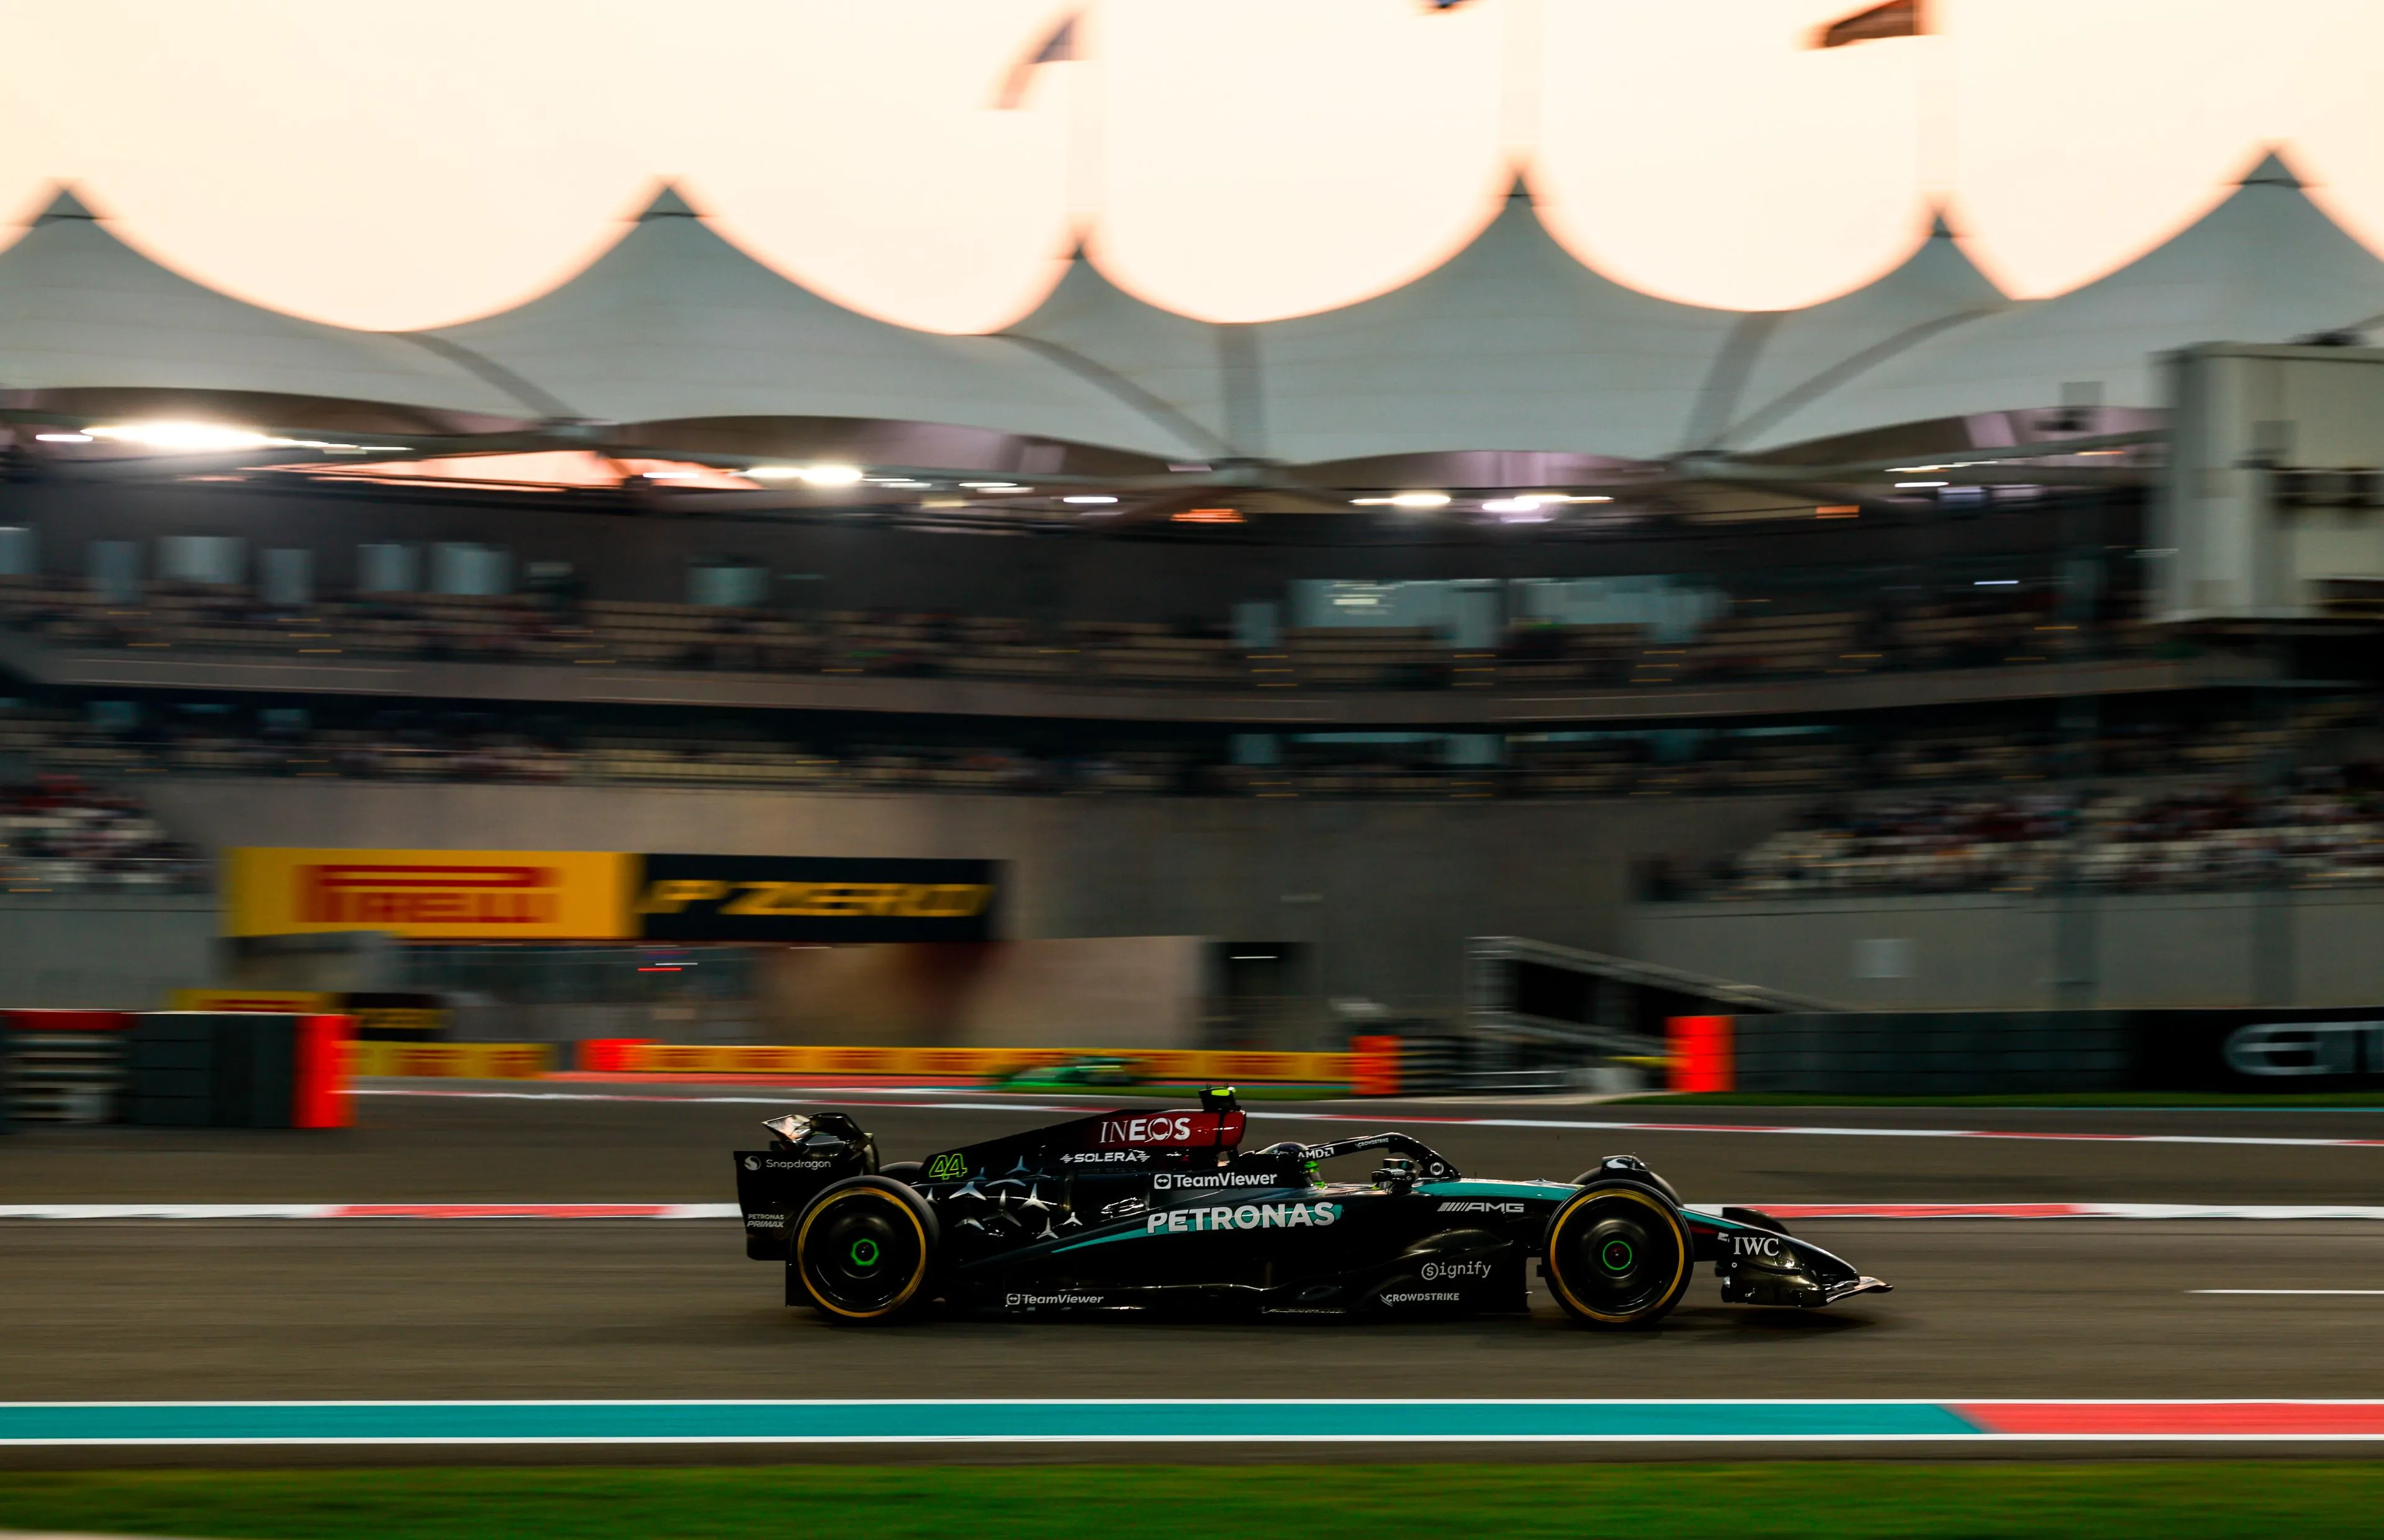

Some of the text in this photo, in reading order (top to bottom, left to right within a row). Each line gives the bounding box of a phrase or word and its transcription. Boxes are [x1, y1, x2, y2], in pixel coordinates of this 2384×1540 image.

[1099, 1117, 1191, 1144] INEOS
[765, 1158, 831, 1170] Snapdragon
[1073, 1151, 1137, 1163] SOLERA
[928, 1153, 968, 1180] 44
[1173, 1172, 1278, 1188] TeamViewer
[746, 1220, 785, 1228] PRIMAX
[1147, 1201, 1335, 1234] PETRONAS
[1733, 1236, 1780, 1257] IWC
[1421, 1261, 1492, 1281] signify
[1022, 1294, 1105, 1305] TeamViewer
[1386, 1292, 1460, 1302] CROWDSTRIKE
